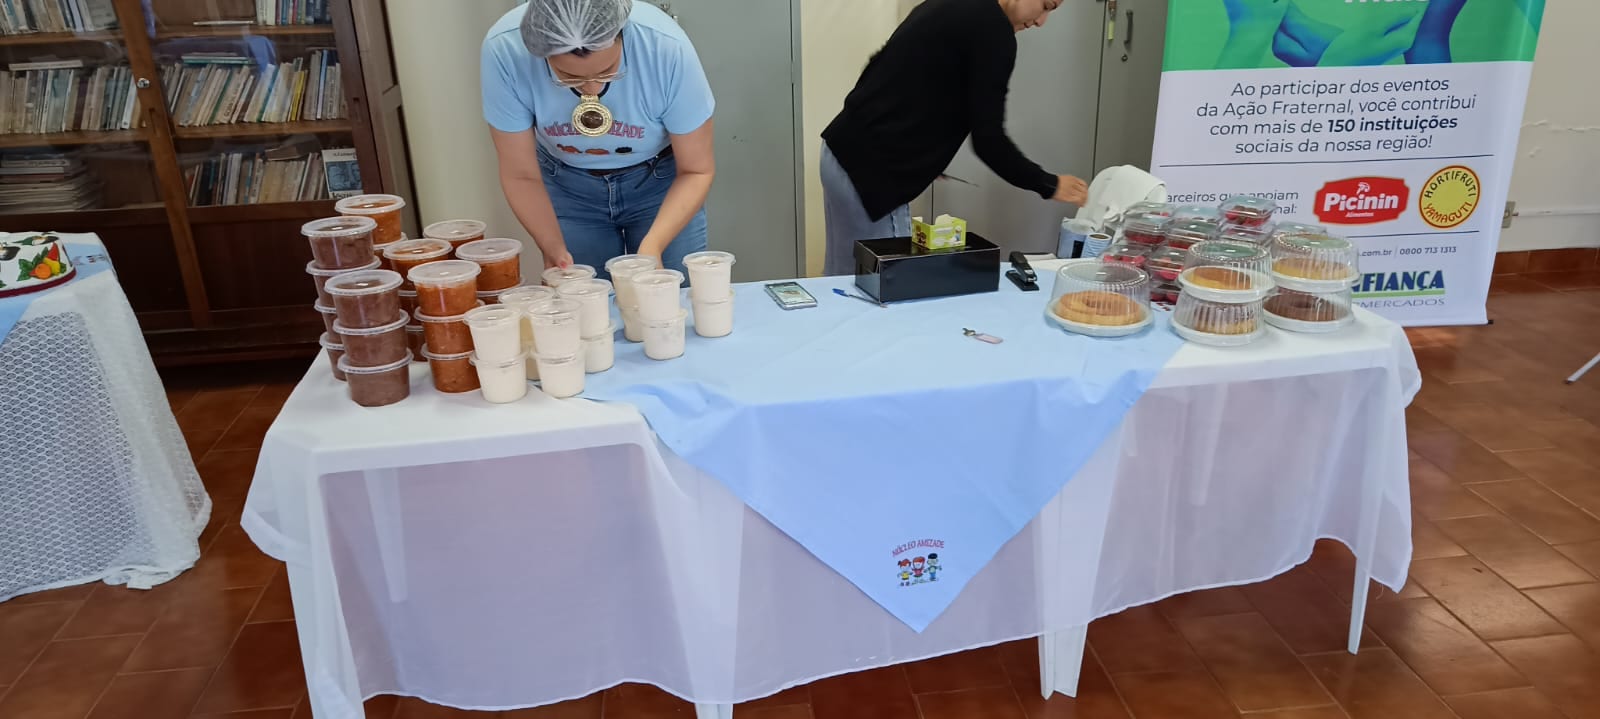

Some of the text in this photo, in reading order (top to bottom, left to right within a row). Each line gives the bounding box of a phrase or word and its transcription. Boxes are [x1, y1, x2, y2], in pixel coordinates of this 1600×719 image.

[1230, 78, 1450, 99] Ao participar dos eventos
[1196, 94, 1477, 120] da Ação Fraternal, você contribui
[543, 120, 645, 139] NÚCL IZADE
[1210, 115, 1458, 136] com mais de 150 instituições
[1235, 135, 1433, 154] sociais da nossa região!
[1423, 170, 1477, 199] HORTIFRUTI
[1168, 191, 1217, 204] arceiros
[1323, 192, 1399, 212] Picinin
[1423, 201, 1473, 224] YAMAGUTI
[1358, 246, 1457, 257] .com.br 0800 713 1313
[1351, 269, 1445, 292] FIANÇA
[1357, 299, 1446, 309] MERCADOS
